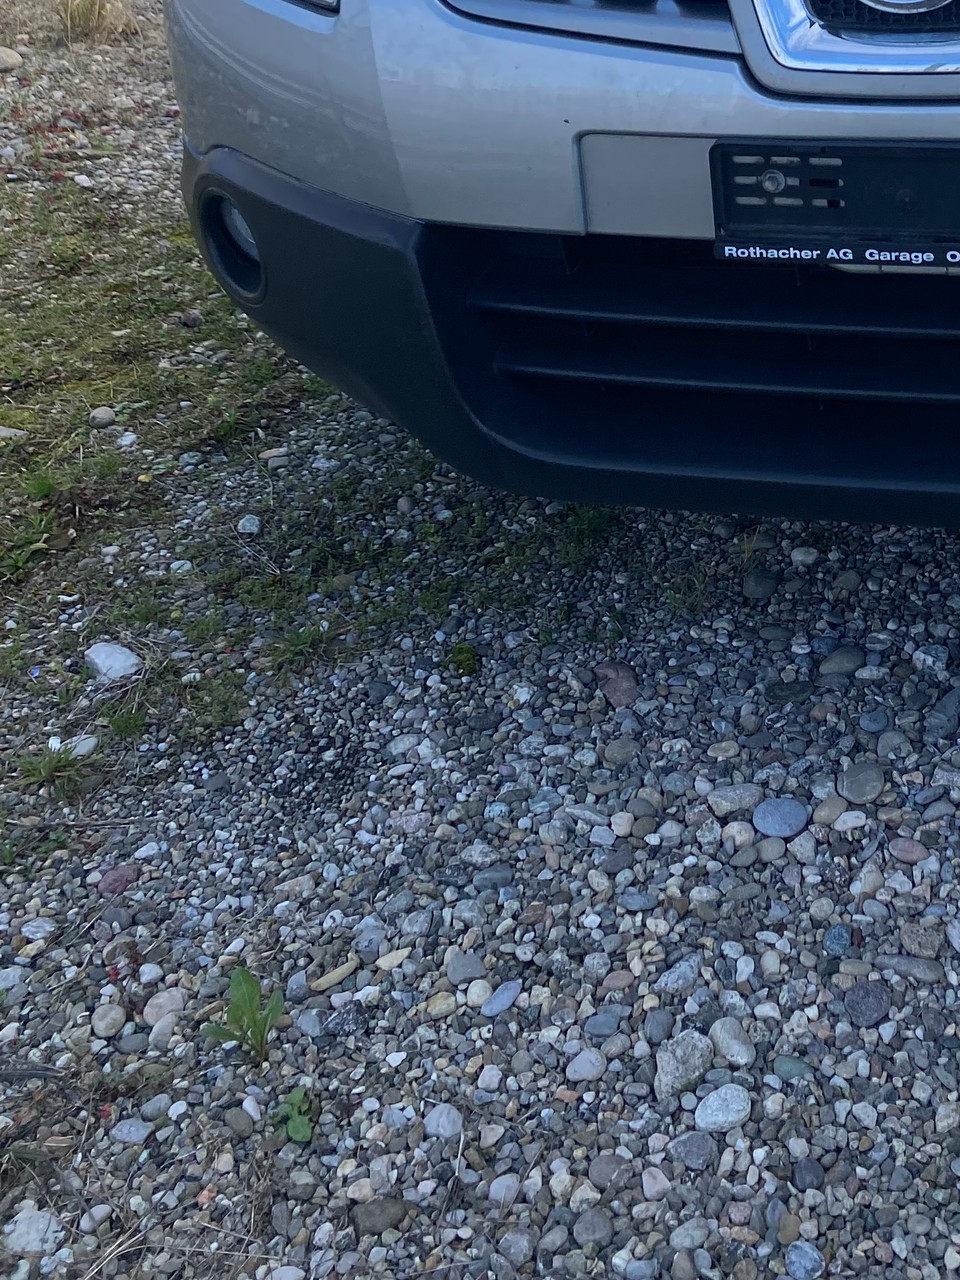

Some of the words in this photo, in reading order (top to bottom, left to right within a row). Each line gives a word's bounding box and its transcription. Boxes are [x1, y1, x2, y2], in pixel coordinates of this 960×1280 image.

[724, 246, 820, 259] Rothacher
[826, 248, 853, 260] AG
[865, 249, 934, 263] Garage
